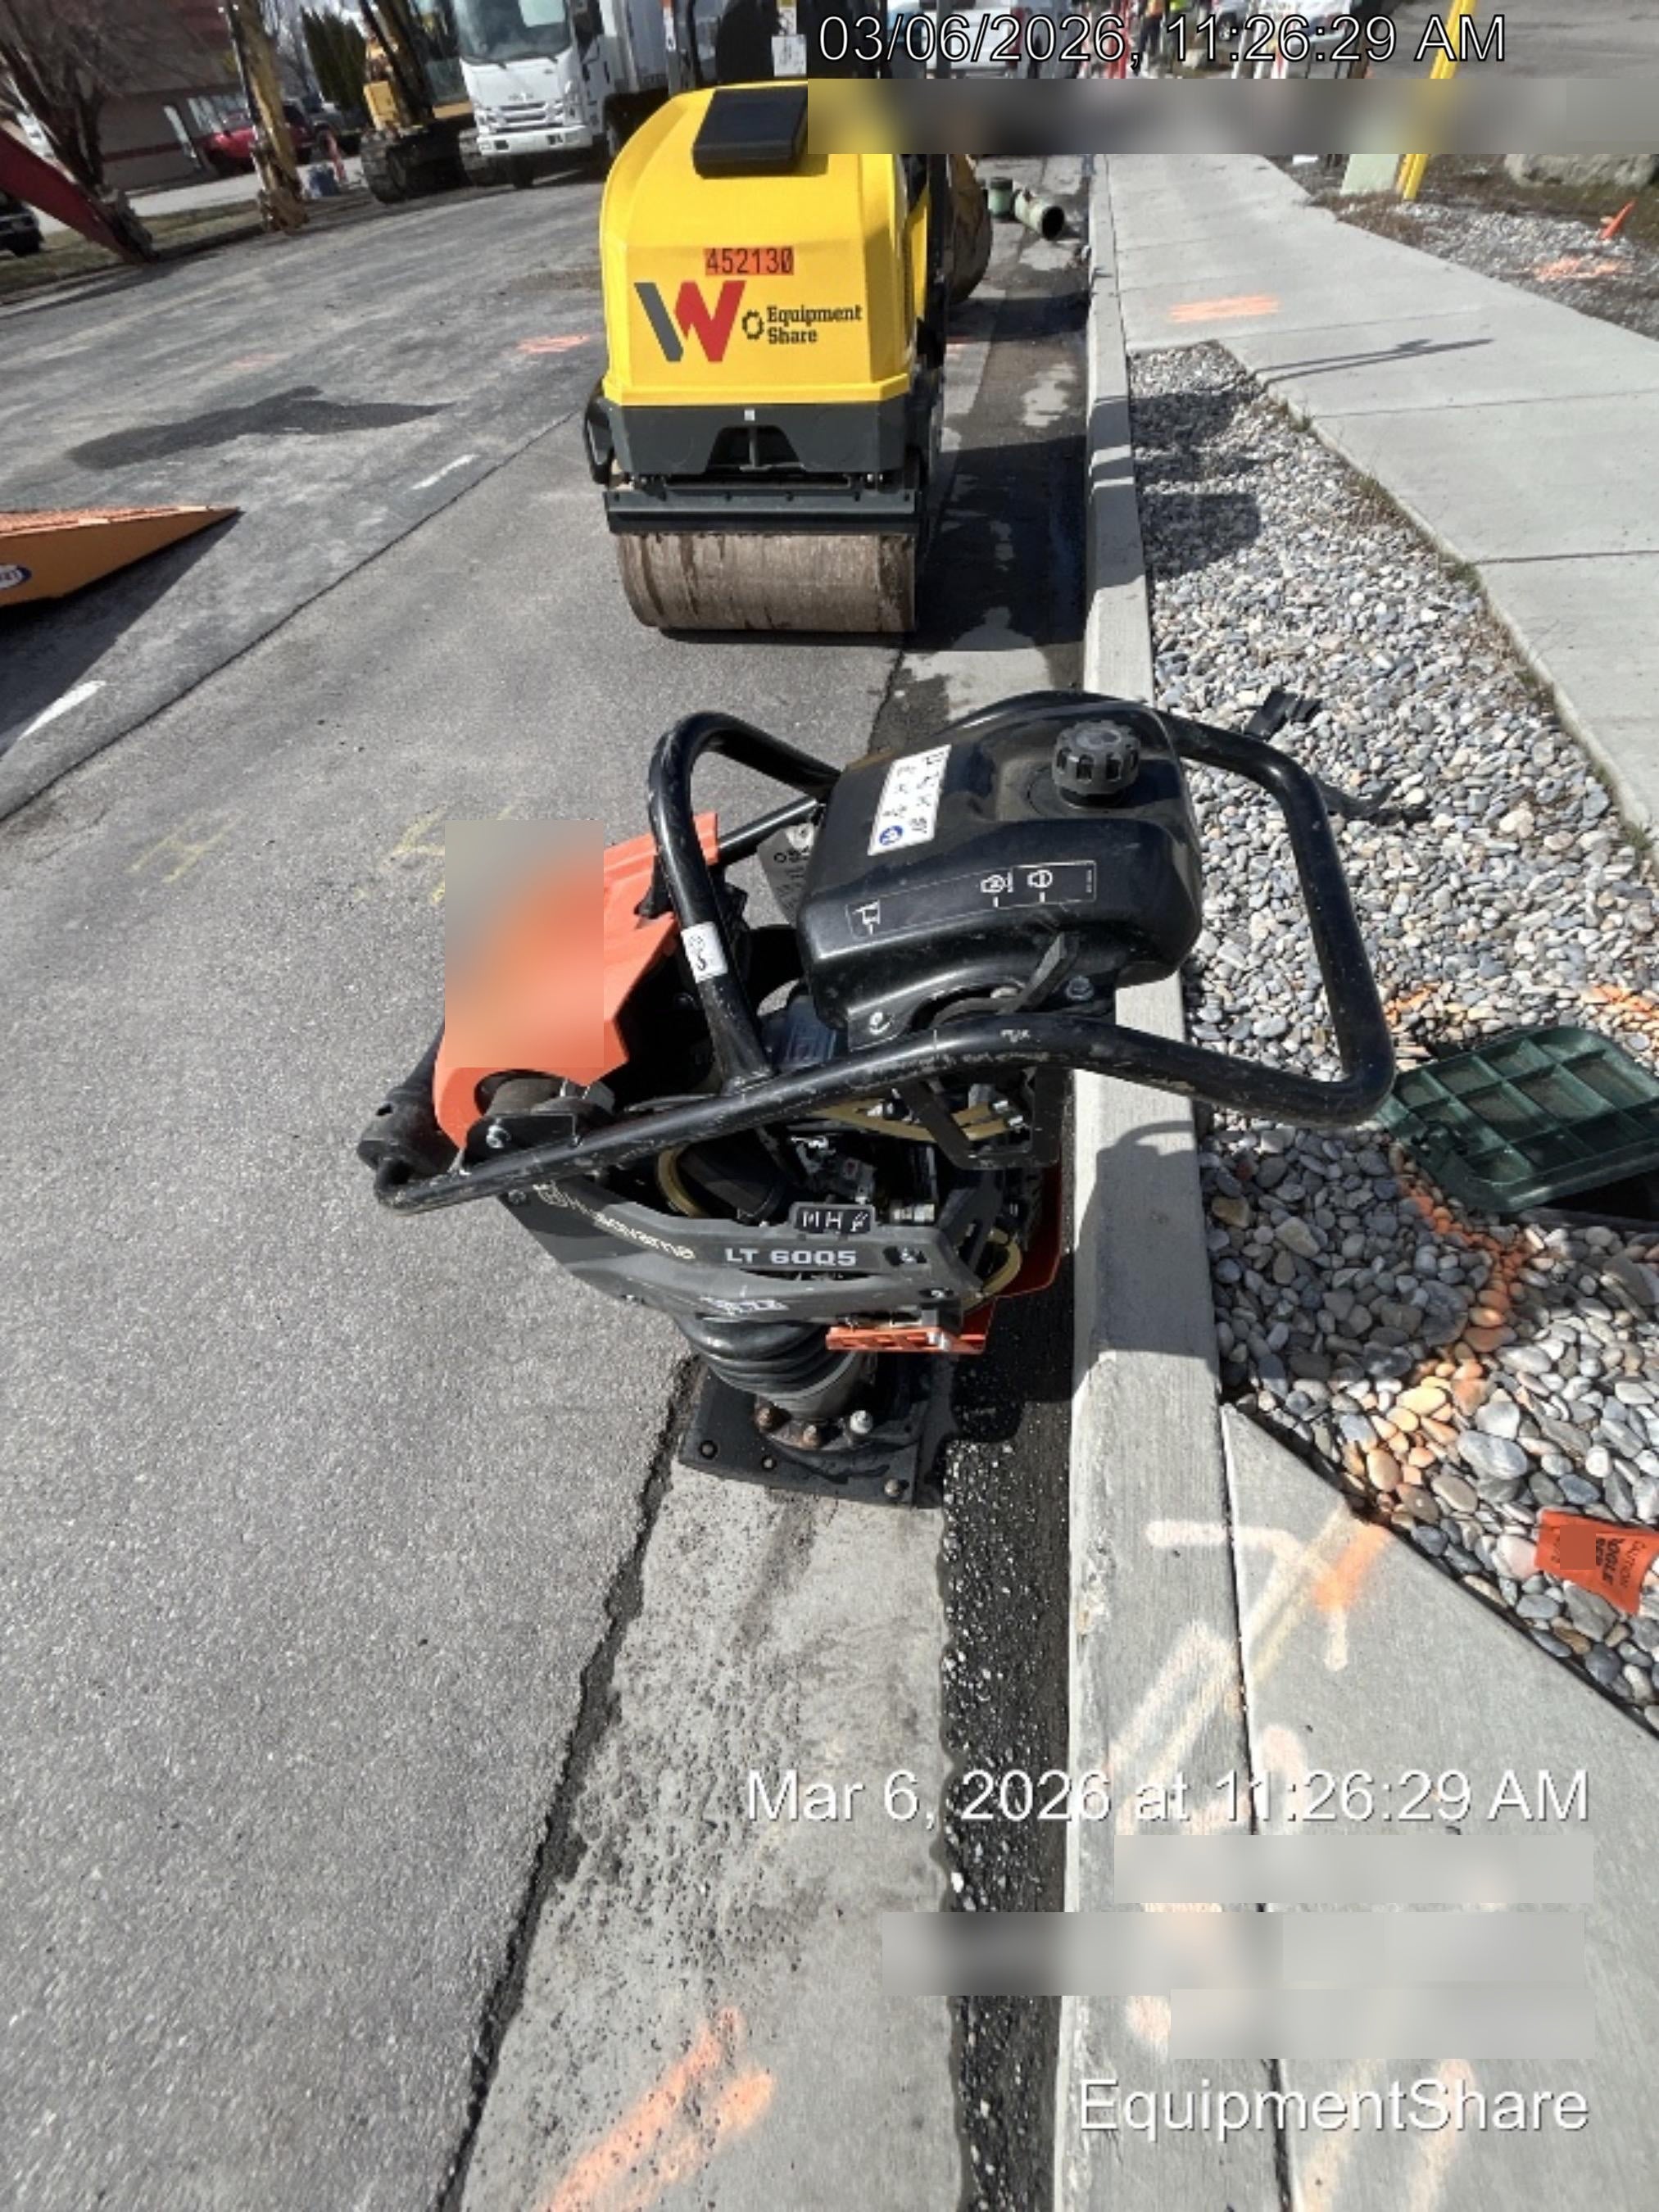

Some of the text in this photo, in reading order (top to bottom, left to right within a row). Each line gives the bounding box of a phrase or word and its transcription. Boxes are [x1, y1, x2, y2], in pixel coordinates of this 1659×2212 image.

[705, 247, 795, 274] 452130
[767, 304, 863, 326] Equipment
[767, 327, 818, 344] Share
[724, 1247, 759, 1264] LT
